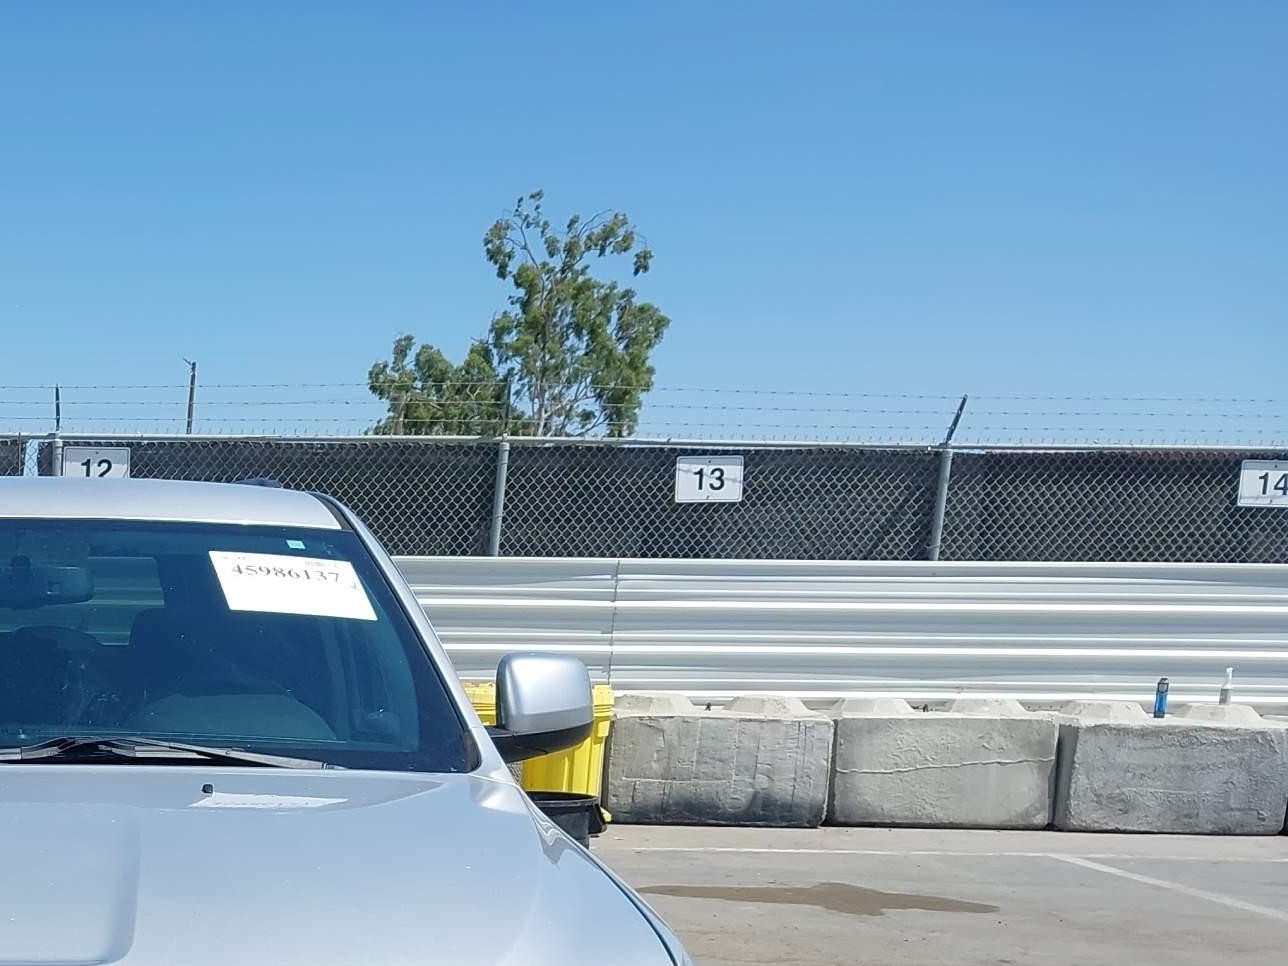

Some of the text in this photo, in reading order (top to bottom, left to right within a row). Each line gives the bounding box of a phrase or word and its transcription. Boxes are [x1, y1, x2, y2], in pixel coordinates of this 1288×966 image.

[81, 459, 112, 477] 12
[693, 468, 725, 490] 13
[1259, 472, 1288, 495] 14
[232, 564, 340, 582] 45986137
